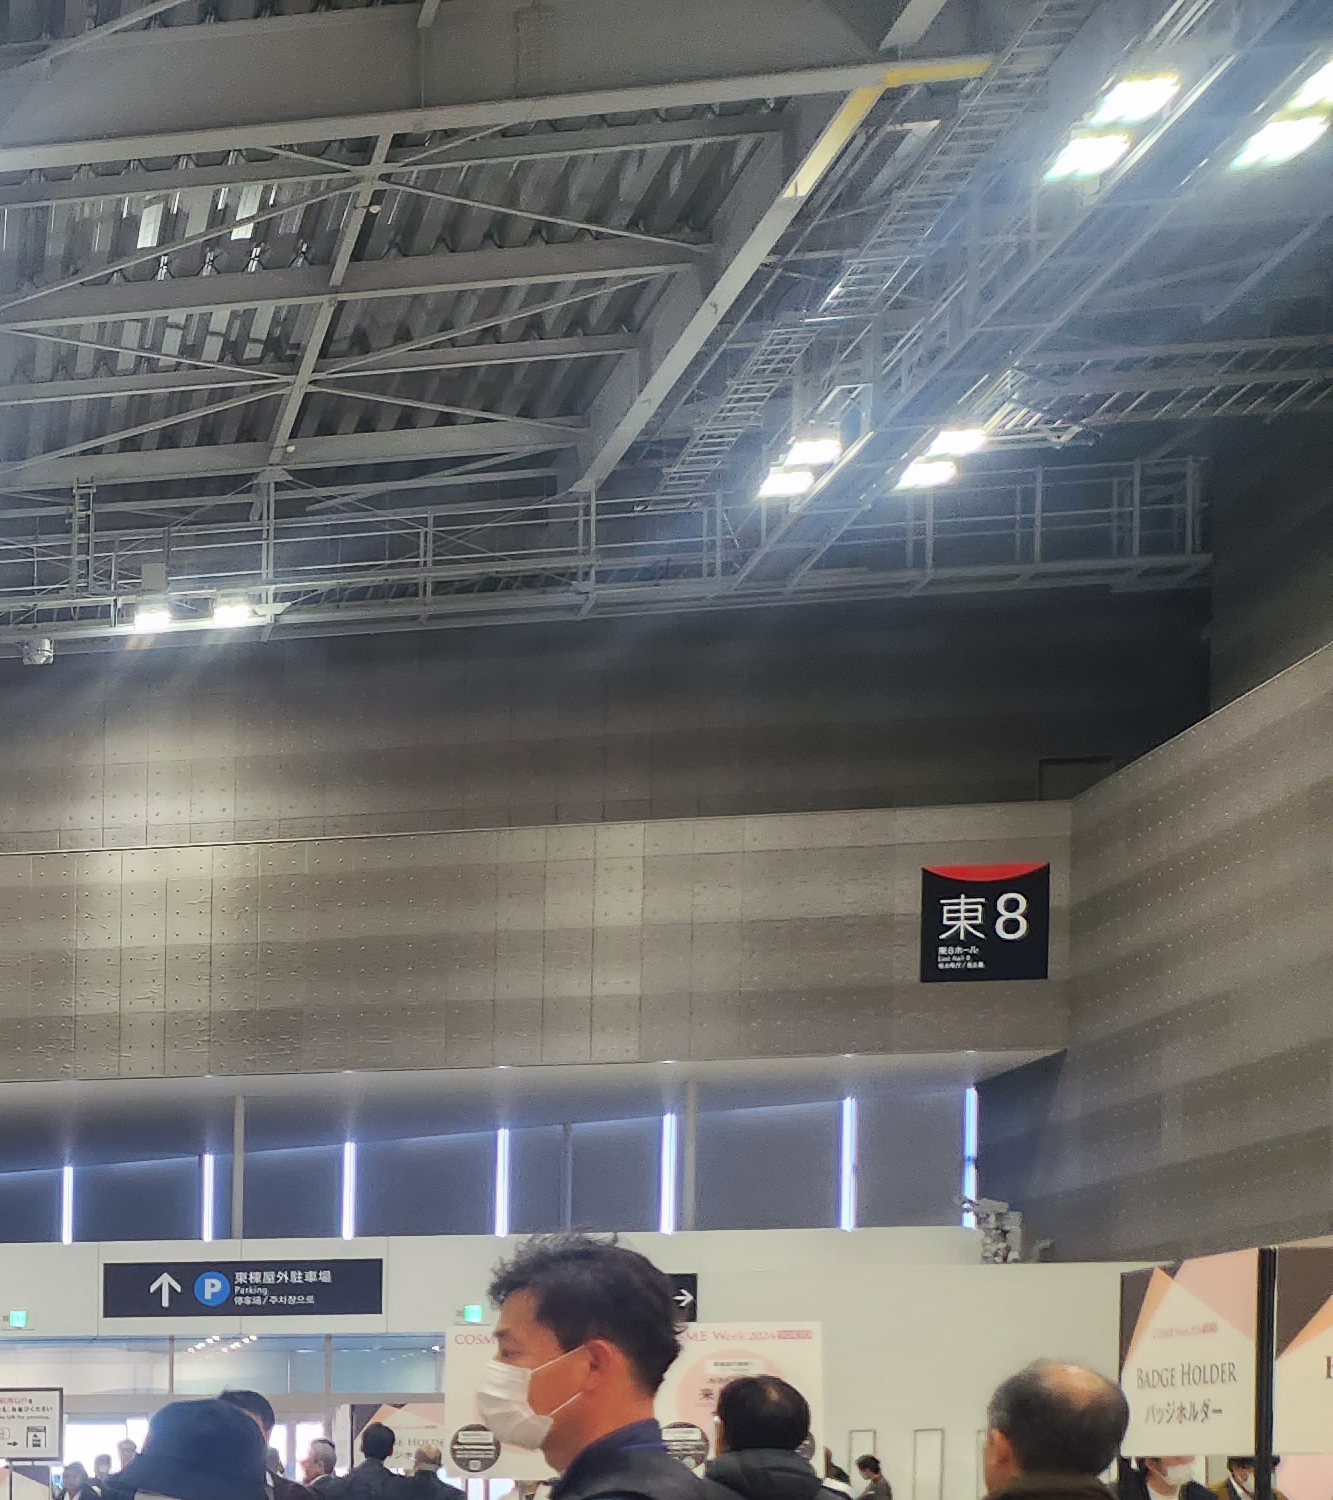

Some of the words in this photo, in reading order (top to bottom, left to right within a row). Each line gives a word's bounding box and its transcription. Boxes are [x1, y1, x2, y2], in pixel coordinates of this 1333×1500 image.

[938, 893, 1030, 941] 東8
[234, 1270, 332, 1284] 東棟屋外駐車場
[234, 1286, 268, 1296] Parking
[454, 1333, 496, 1345] COSM
[712, 1330, 743, 1341] Week
[1136, 1367, 1177, 1391] BADGE
[1180, 1361, 1238, 1386] HOLDER
[1144, 1398, 1223, 1424] バッジホルダー
